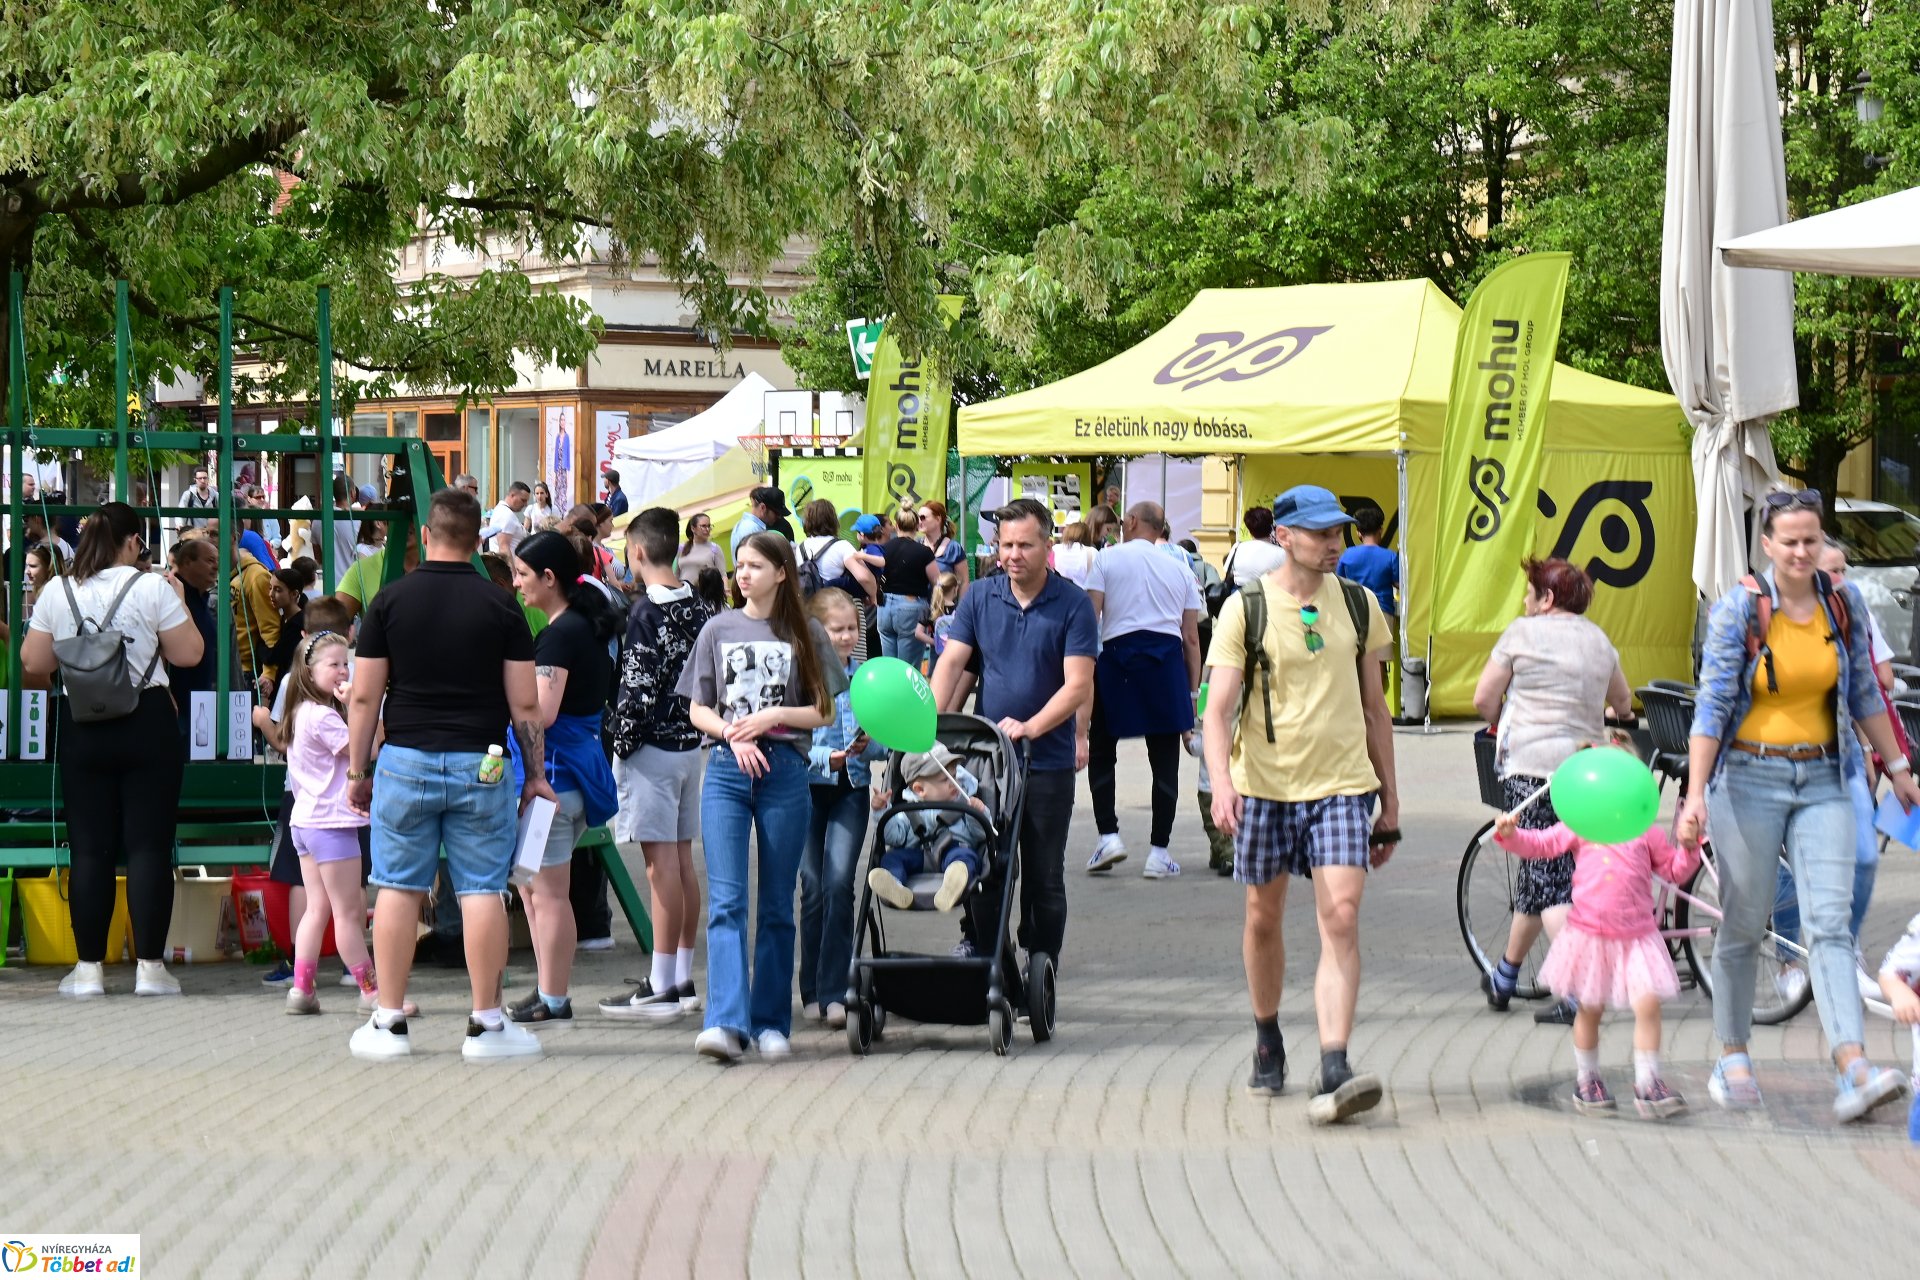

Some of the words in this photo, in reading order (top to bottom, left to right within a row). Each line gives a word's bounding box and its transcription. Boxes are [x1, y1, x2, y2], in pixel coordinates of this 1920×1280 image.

[1524, 320, 1534, 356] GROUP
[643, 358, 746, 379] MARELLA
[1478, 319, 1520, 440] mohu
[1522, 359, 1531, 380] MOL
[1520, 384, 1528, 396] OF
[1074, 418, 1091, 437] Ez
[1094, 416, 1150, 437] életünk
[1153, 420, 1189, 441] nagy
[1193, 416, 1253, 439] dobása.
[1518, 400, 1527, 440] MEMBER
[836, 471, 852, 482] mohu
